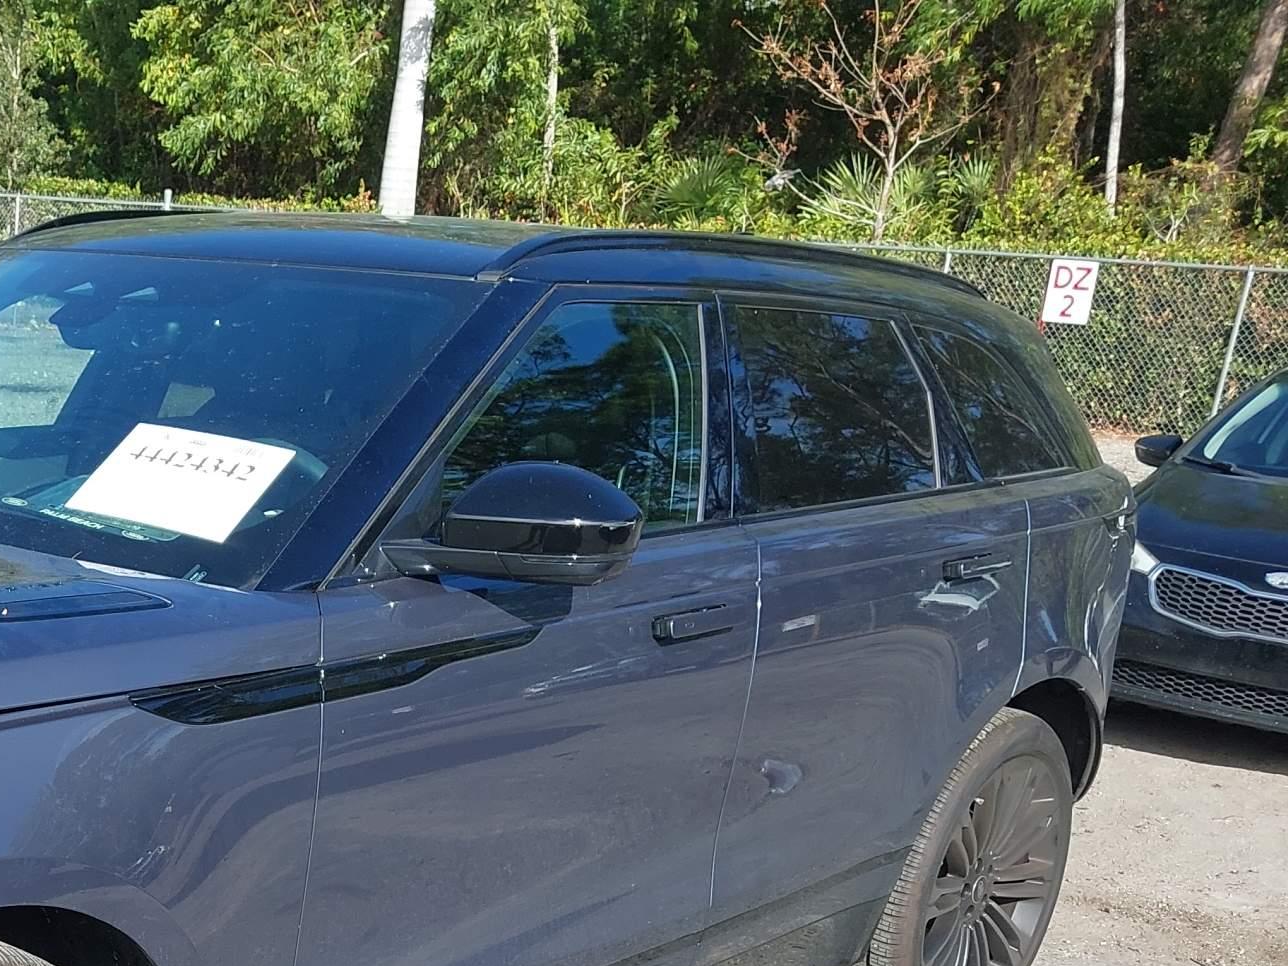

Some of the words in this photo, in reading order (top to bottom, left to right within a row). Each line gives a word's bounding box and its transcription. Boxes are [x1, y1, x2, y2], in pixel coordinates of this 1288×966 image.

[1053, 265, 1093, 291] DZ
[1059, 294, 1075, 317] 2
[129, 446, 256, 482] 44424342
[39, 508, 71, 520] PALM
[67, 516, 105, 530] BEACH
